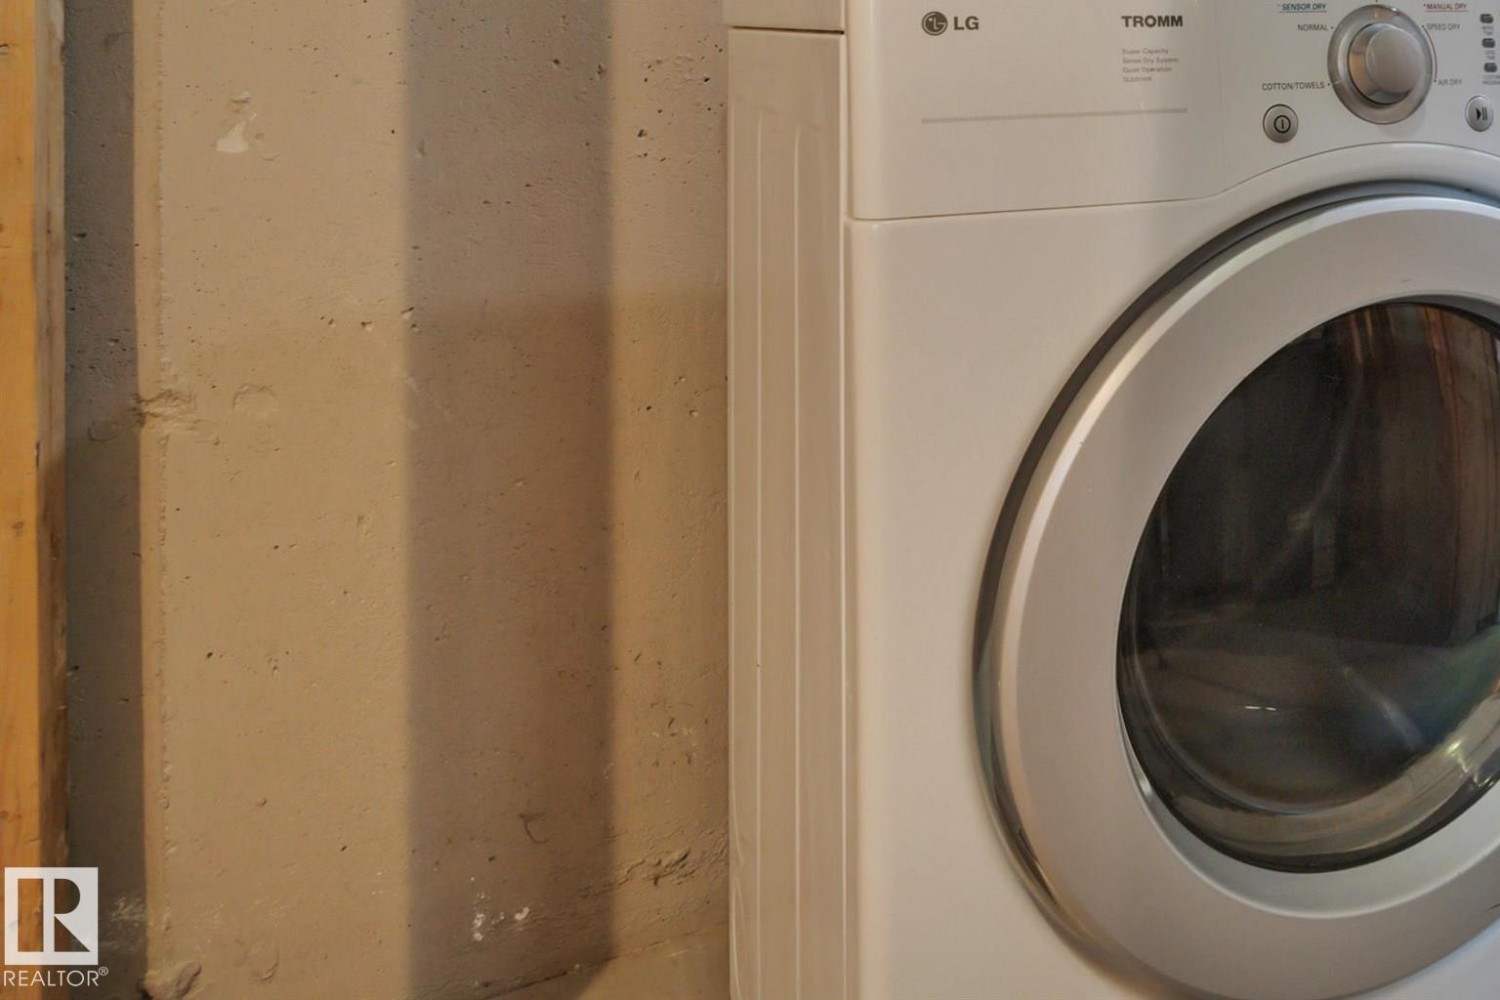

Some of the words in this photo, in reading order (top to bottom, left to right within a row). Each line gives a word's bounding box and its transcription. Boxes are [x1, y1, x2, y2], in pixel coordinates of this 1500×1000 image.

[1281, 3, 1310, 11] SENSOR
[953, 15, 980, 31] LG
[1121, 15, 1184, 28] TROMM
[1297, 23, 1329, 31] NORMAL
[1427, 23, 1447, 31] SPEED
[1262, 81, 1326, 91] COTTON/TOWELS
